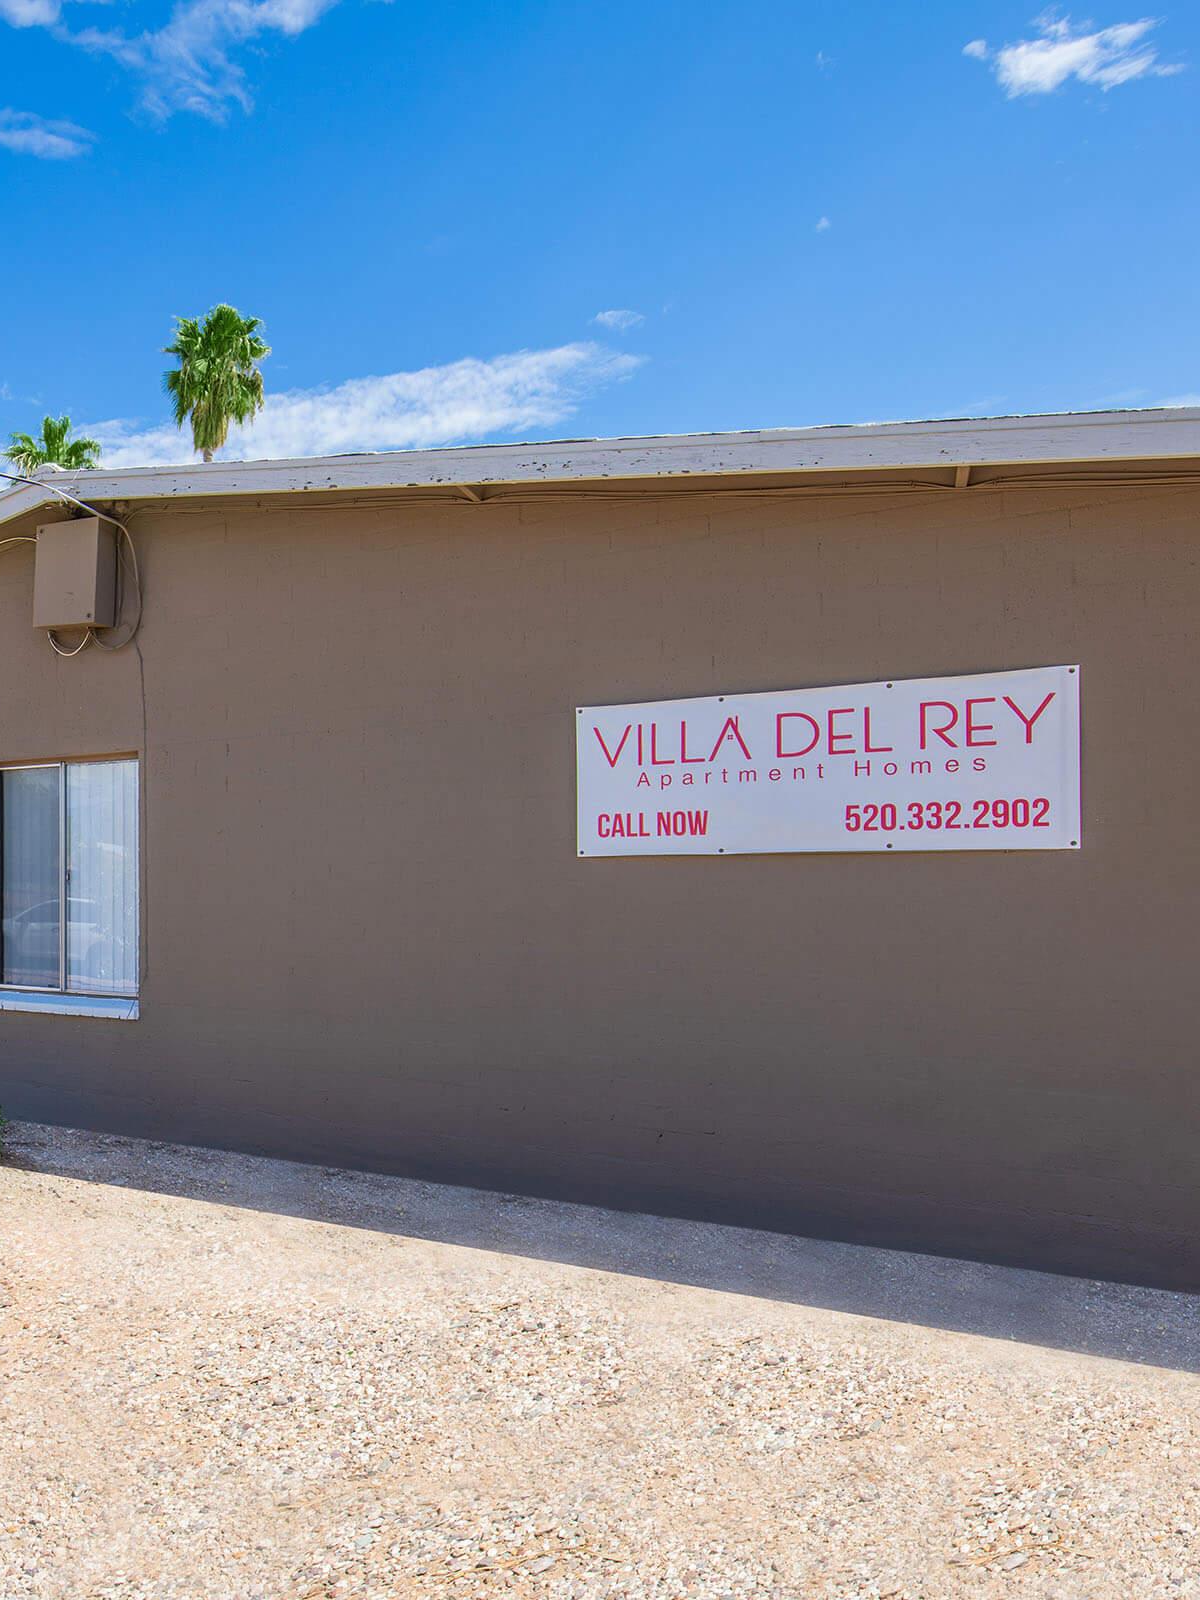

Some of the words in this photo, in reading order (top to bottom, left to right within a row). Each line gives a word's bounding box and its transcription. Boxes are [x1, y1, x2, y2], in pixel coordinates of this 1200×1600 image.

[593, 715, 752, 768] VILLA
[775, 707, 893, 758] DEL
[918, 692, 1056, 751] REY
[636, 761, 825, 790] Apartment
[853, 757, 987, 777] Homes
[597, 811, 650, 838] CALL
[656, 809, 708, 837] NOW
[845, 797, 1050, 832] 520.332.2902
